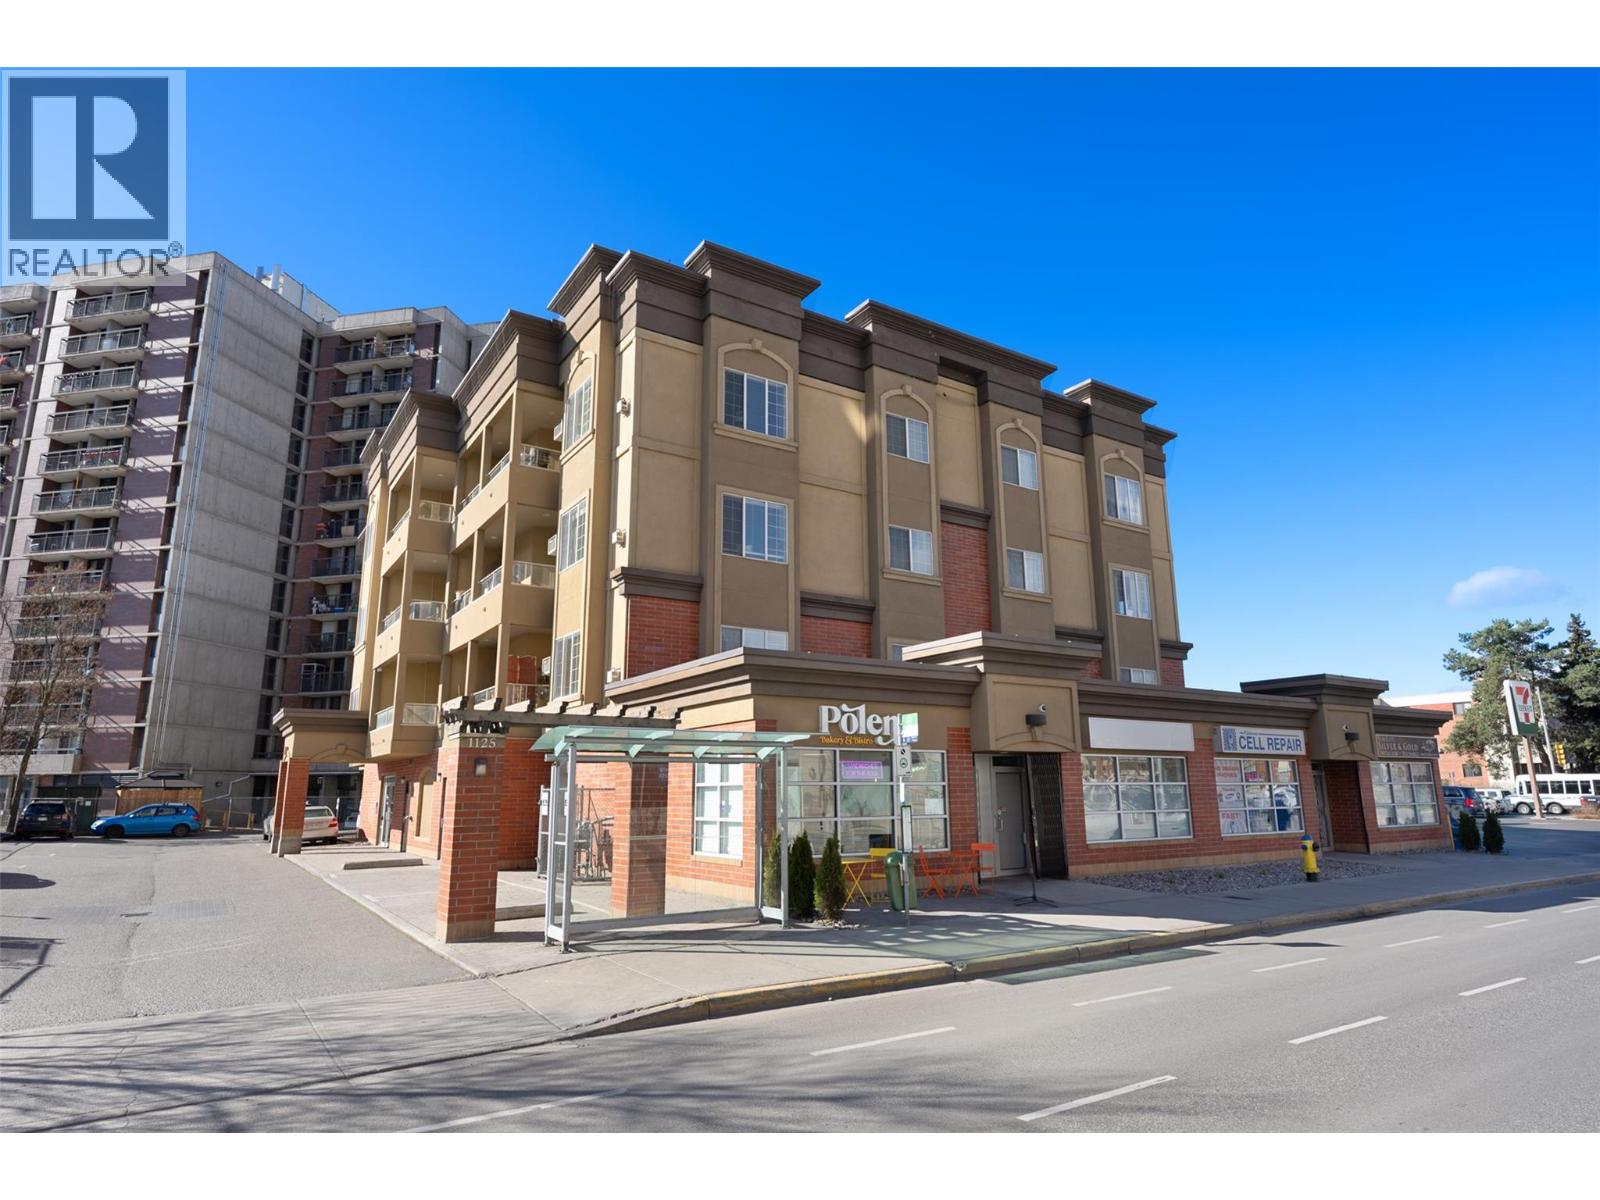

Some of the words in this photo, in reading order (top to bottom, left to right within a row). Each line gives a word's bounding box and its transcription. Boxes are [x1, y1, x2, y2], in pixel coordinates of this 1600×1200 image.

[469, 738, 496, 748] 1125
[845, 735, 852, 745] &
[1239, 735, 1265, 750] CELL
[1267, 737, 1302, 752] REPAIR
